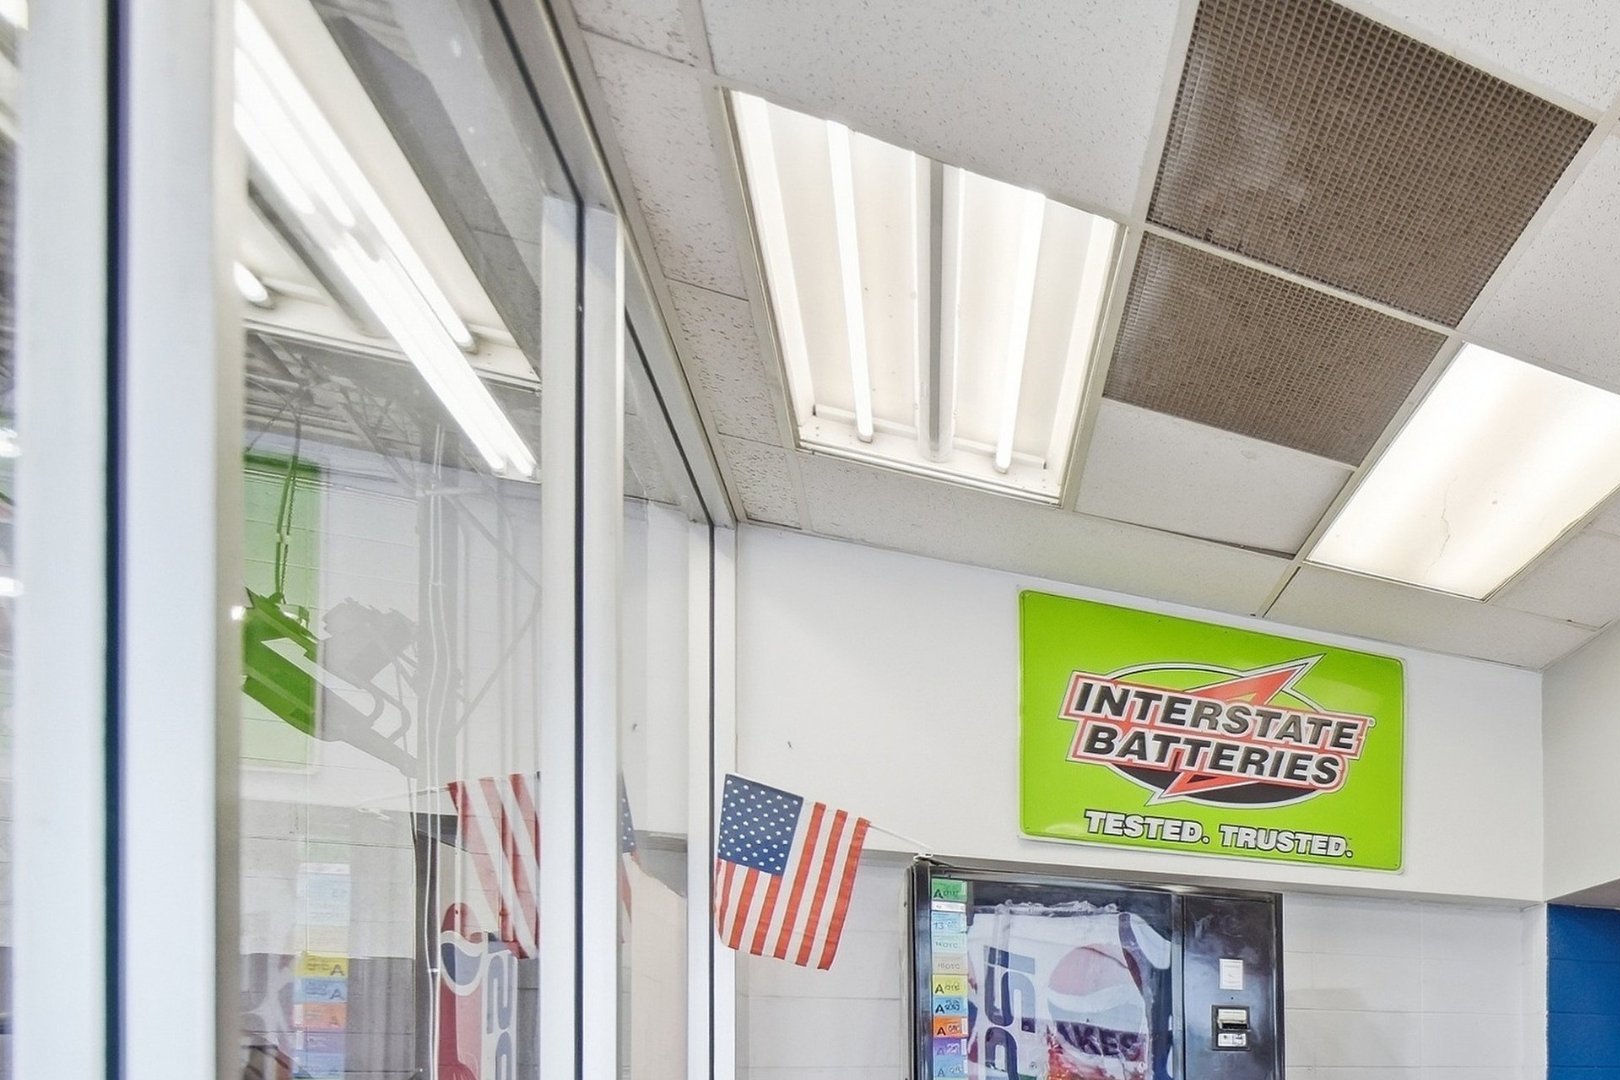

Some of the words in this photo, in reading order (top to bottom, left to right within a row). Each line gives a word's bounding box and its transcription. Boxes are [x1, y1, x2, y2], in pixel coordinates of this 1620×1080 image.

[1073, 682, 1359, 751] INTERSTATE
[1083, 724, 1341, 785] BATTERIES
[1084, 809, 1210, 845] TESTED.
[1219, 825, 1354, 858] TRUSTED.
